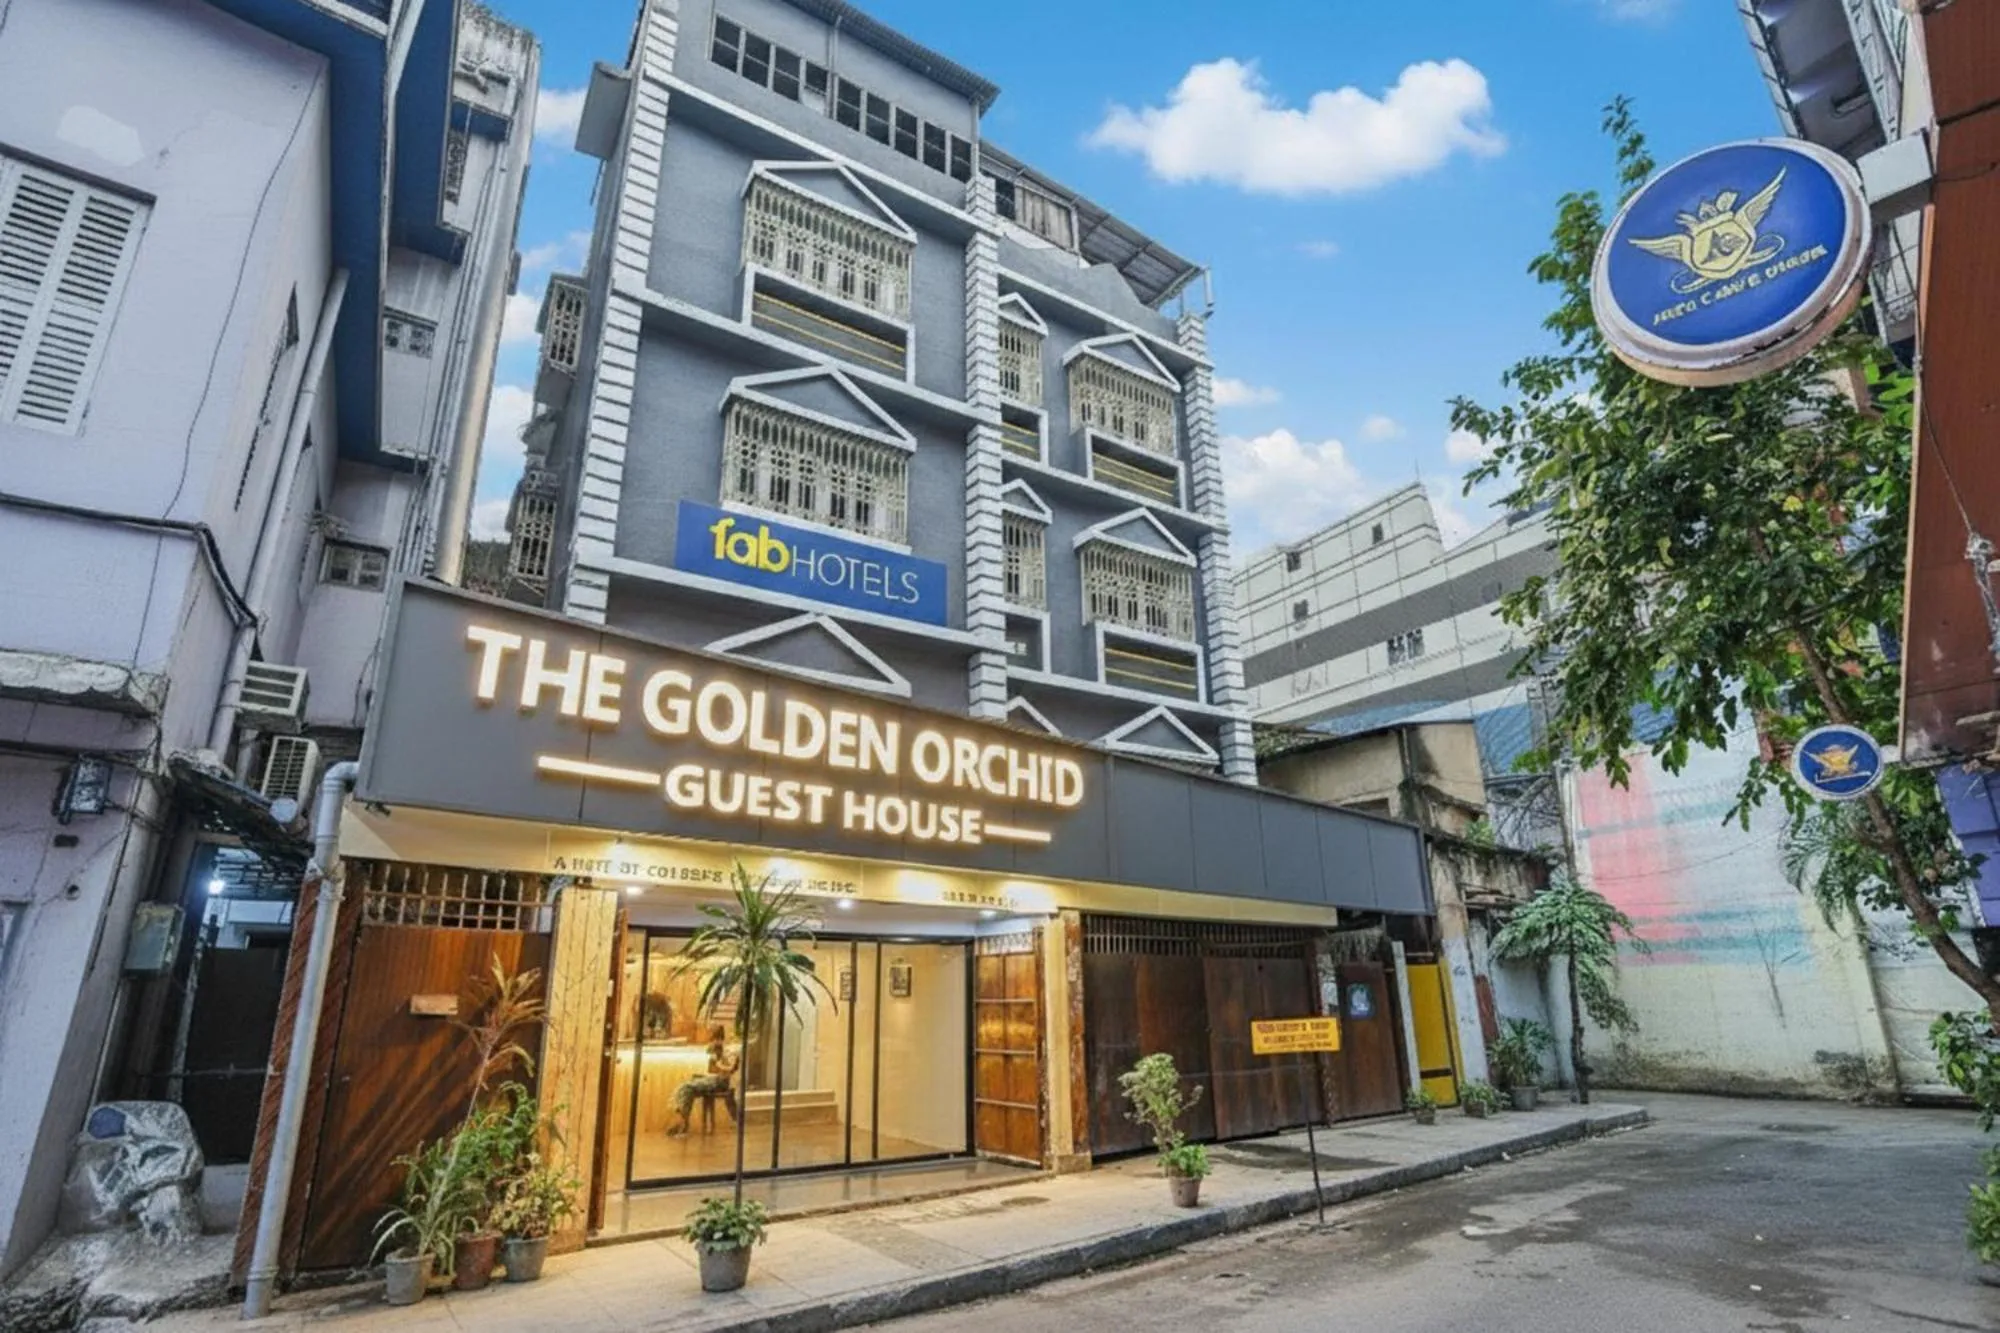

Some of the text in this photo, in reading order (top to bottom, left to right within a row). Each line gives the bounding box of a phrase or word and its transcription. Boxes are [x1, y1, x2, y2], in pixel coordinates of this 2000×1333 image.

[466, 625, 1085, 808] THE GOLDEN ORCHID
[664, 763, 983, 845] GUEST HOUSE
